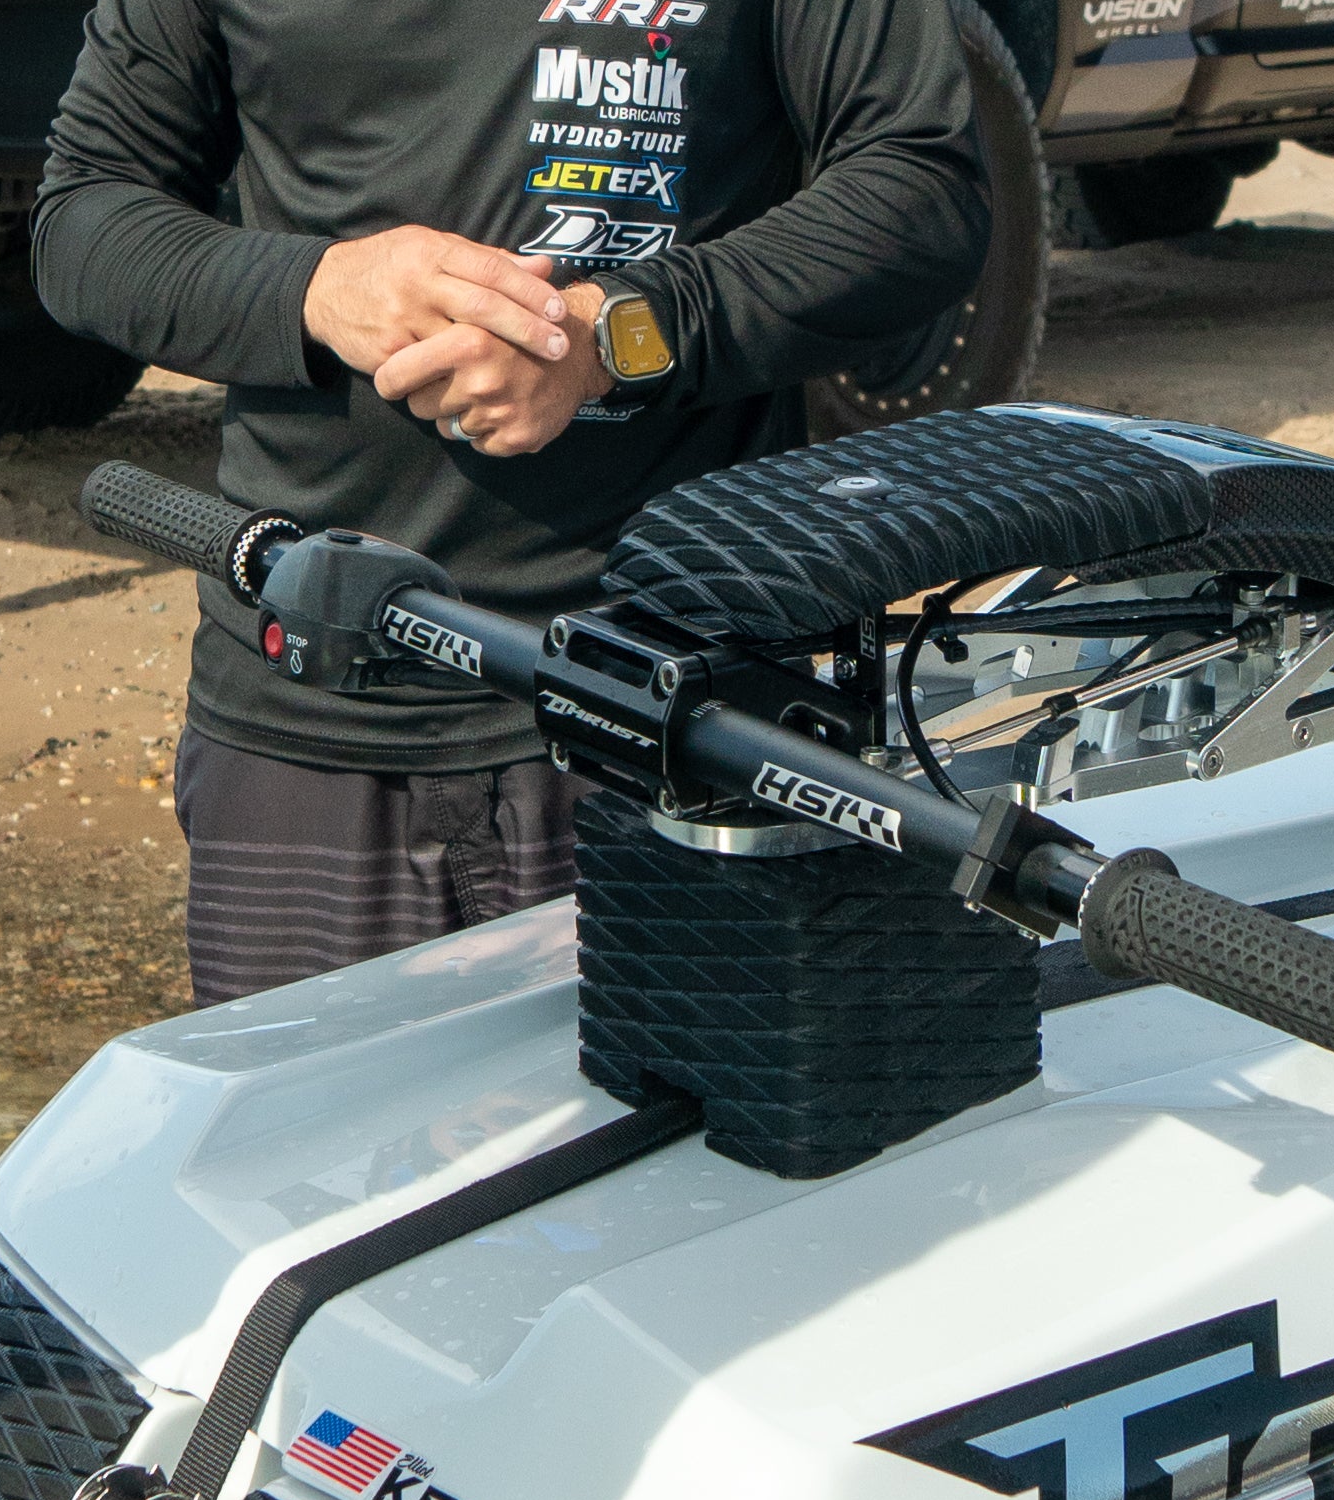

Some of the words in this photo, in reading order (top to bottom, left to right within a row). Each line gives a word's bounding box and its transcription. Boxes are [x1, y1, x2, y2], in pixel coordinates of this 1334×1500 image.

[1094, 22, 1160, 39] WHEEL
[534, 46, 688, 109] Mystik
[599, 105, 682, 126] LUBRICANTS
[528, 122, 687, 154] HYDRO-TURF
[531, 161, 677, 207] JETEFX
[286, 632, 309, 649] STOP
